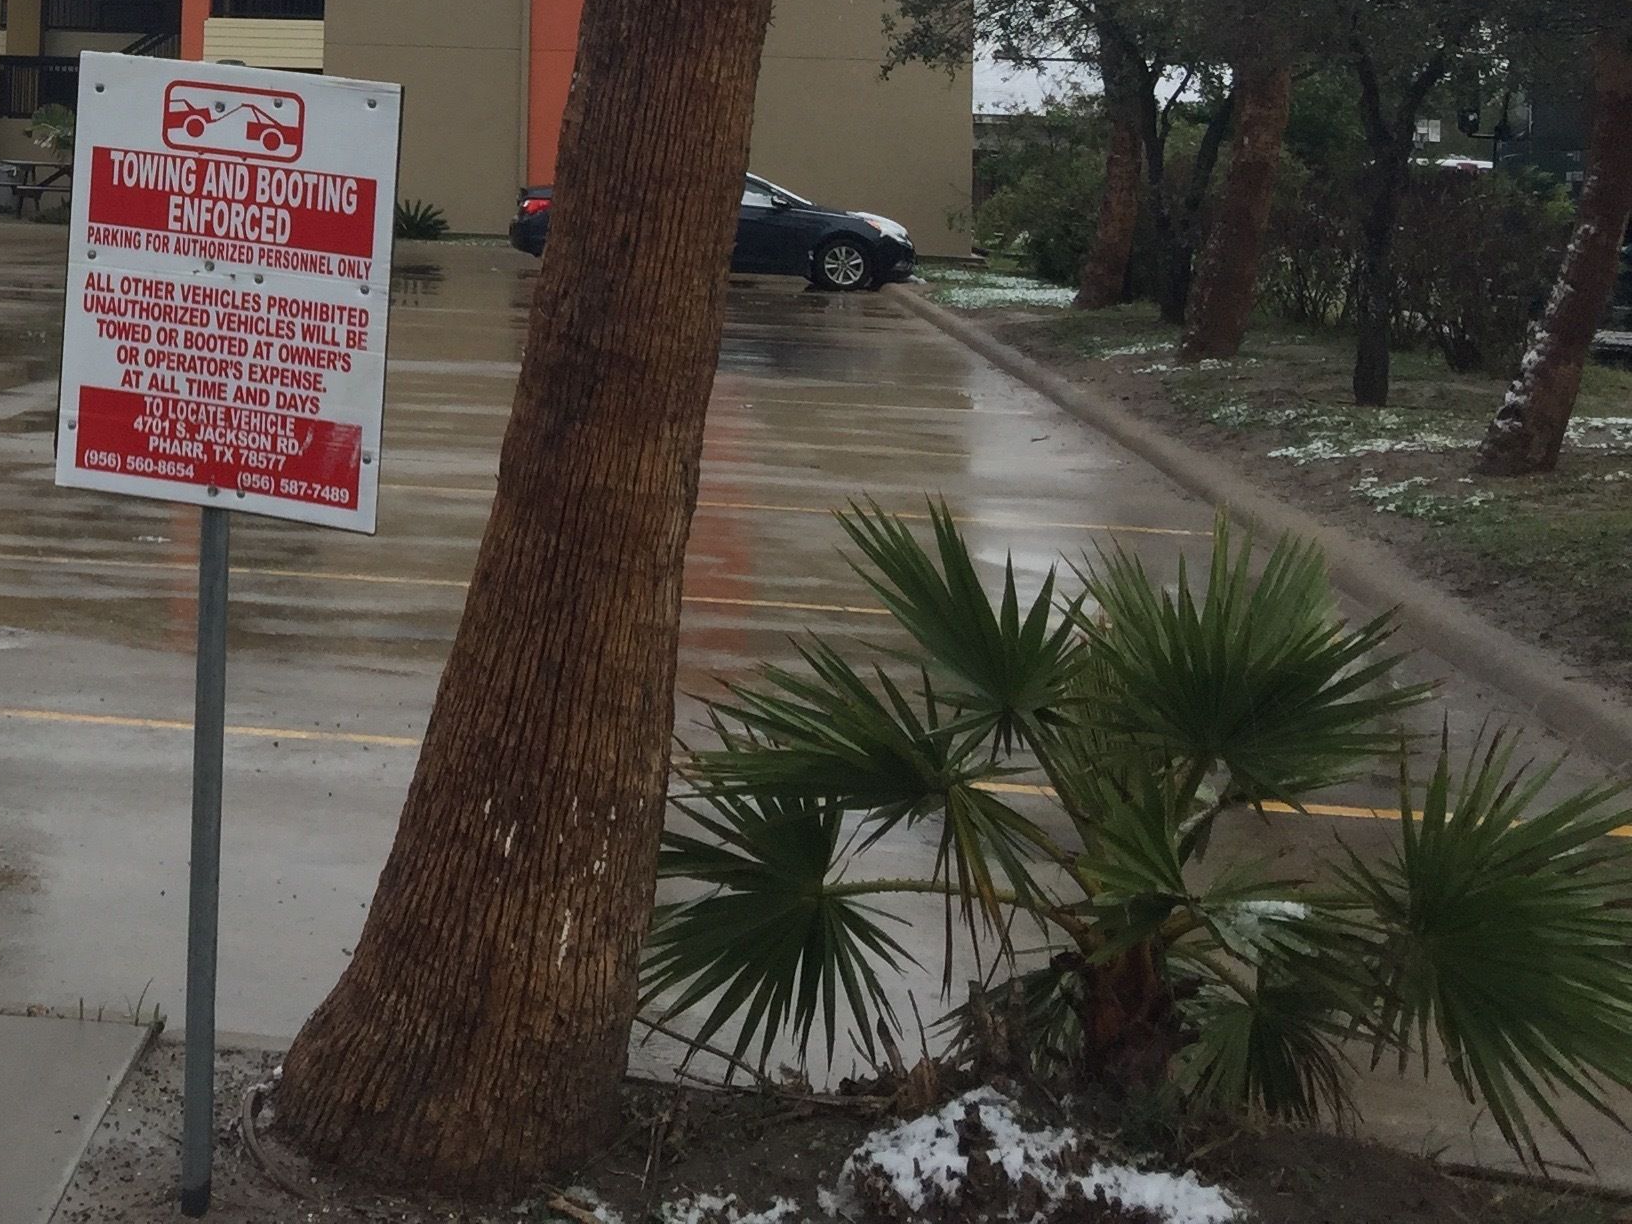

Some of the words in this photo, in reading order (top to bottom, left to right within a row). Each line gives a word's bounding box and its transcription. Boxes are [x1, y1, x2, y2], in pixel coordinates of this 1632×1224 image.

[110, 150, 197, 194] TOWING
[202, 161, 249, 200] AND
[256, 167, 358, 215] BOOTING
[168, 194, 291, 245] ENFORCED
[87, 226, 141, 250] PARKING
[146, 231, 169, 254] FOR
[173, 236, 254, 264] AUTHORIZED
[258, 247, 333, 275] PERSONNEL
[338, 258, 373, 281] ONLY
[83, 293, 210, 328] UNAUTHORIZED
[216, 311, 296, 340] VEHICLES
[301, 322, 340, 347] WILL
[346, 329, 369, 351] BE
[85, 272, 115, 293] ALL
[120, 276, 175, 301] OTHER
[180, 283, 262, 313] VEHICLES
[267, 295, 369, 328] PROHIBITED
[96, 318, 152, 344] TOWED
[156, 327, 179, 348] OR
[183, 330, 249, 357] BOOTED
[252, 340, 274, 361] AT
[117, 344, 140, 366] OR
[248, 363, 327, 393] EXPENSE.
[121, 369, 144, 389] AT
[148, 372, 180, 395] ALL
[185, 377, 228, 401] TIME
[233, 385, 270, 407] AND
[275, 391, 321, 415] DAYS
[133, 415, 169, 436] 4701
[175, 420, 190, 439] S.
[195, 424, 272, 452] JACKSON
[276, 436, 303, 456] RD.
[144, 396, 163, 416] TO
[168, 399, 226, 427] LOCATE
[230, 408, 296, 437] VEHICLE
[84, 449, 121, 472] (956)
[126, 455, 195, 479] 560-8654
[148, 435, 208, 463] PHARR,
[212, 444, 234, 464] TX
[239, 448, 287, 472] 78577
[237, 471, 275, 494] (956)
[279, 478, 350, 504] 587-7489
